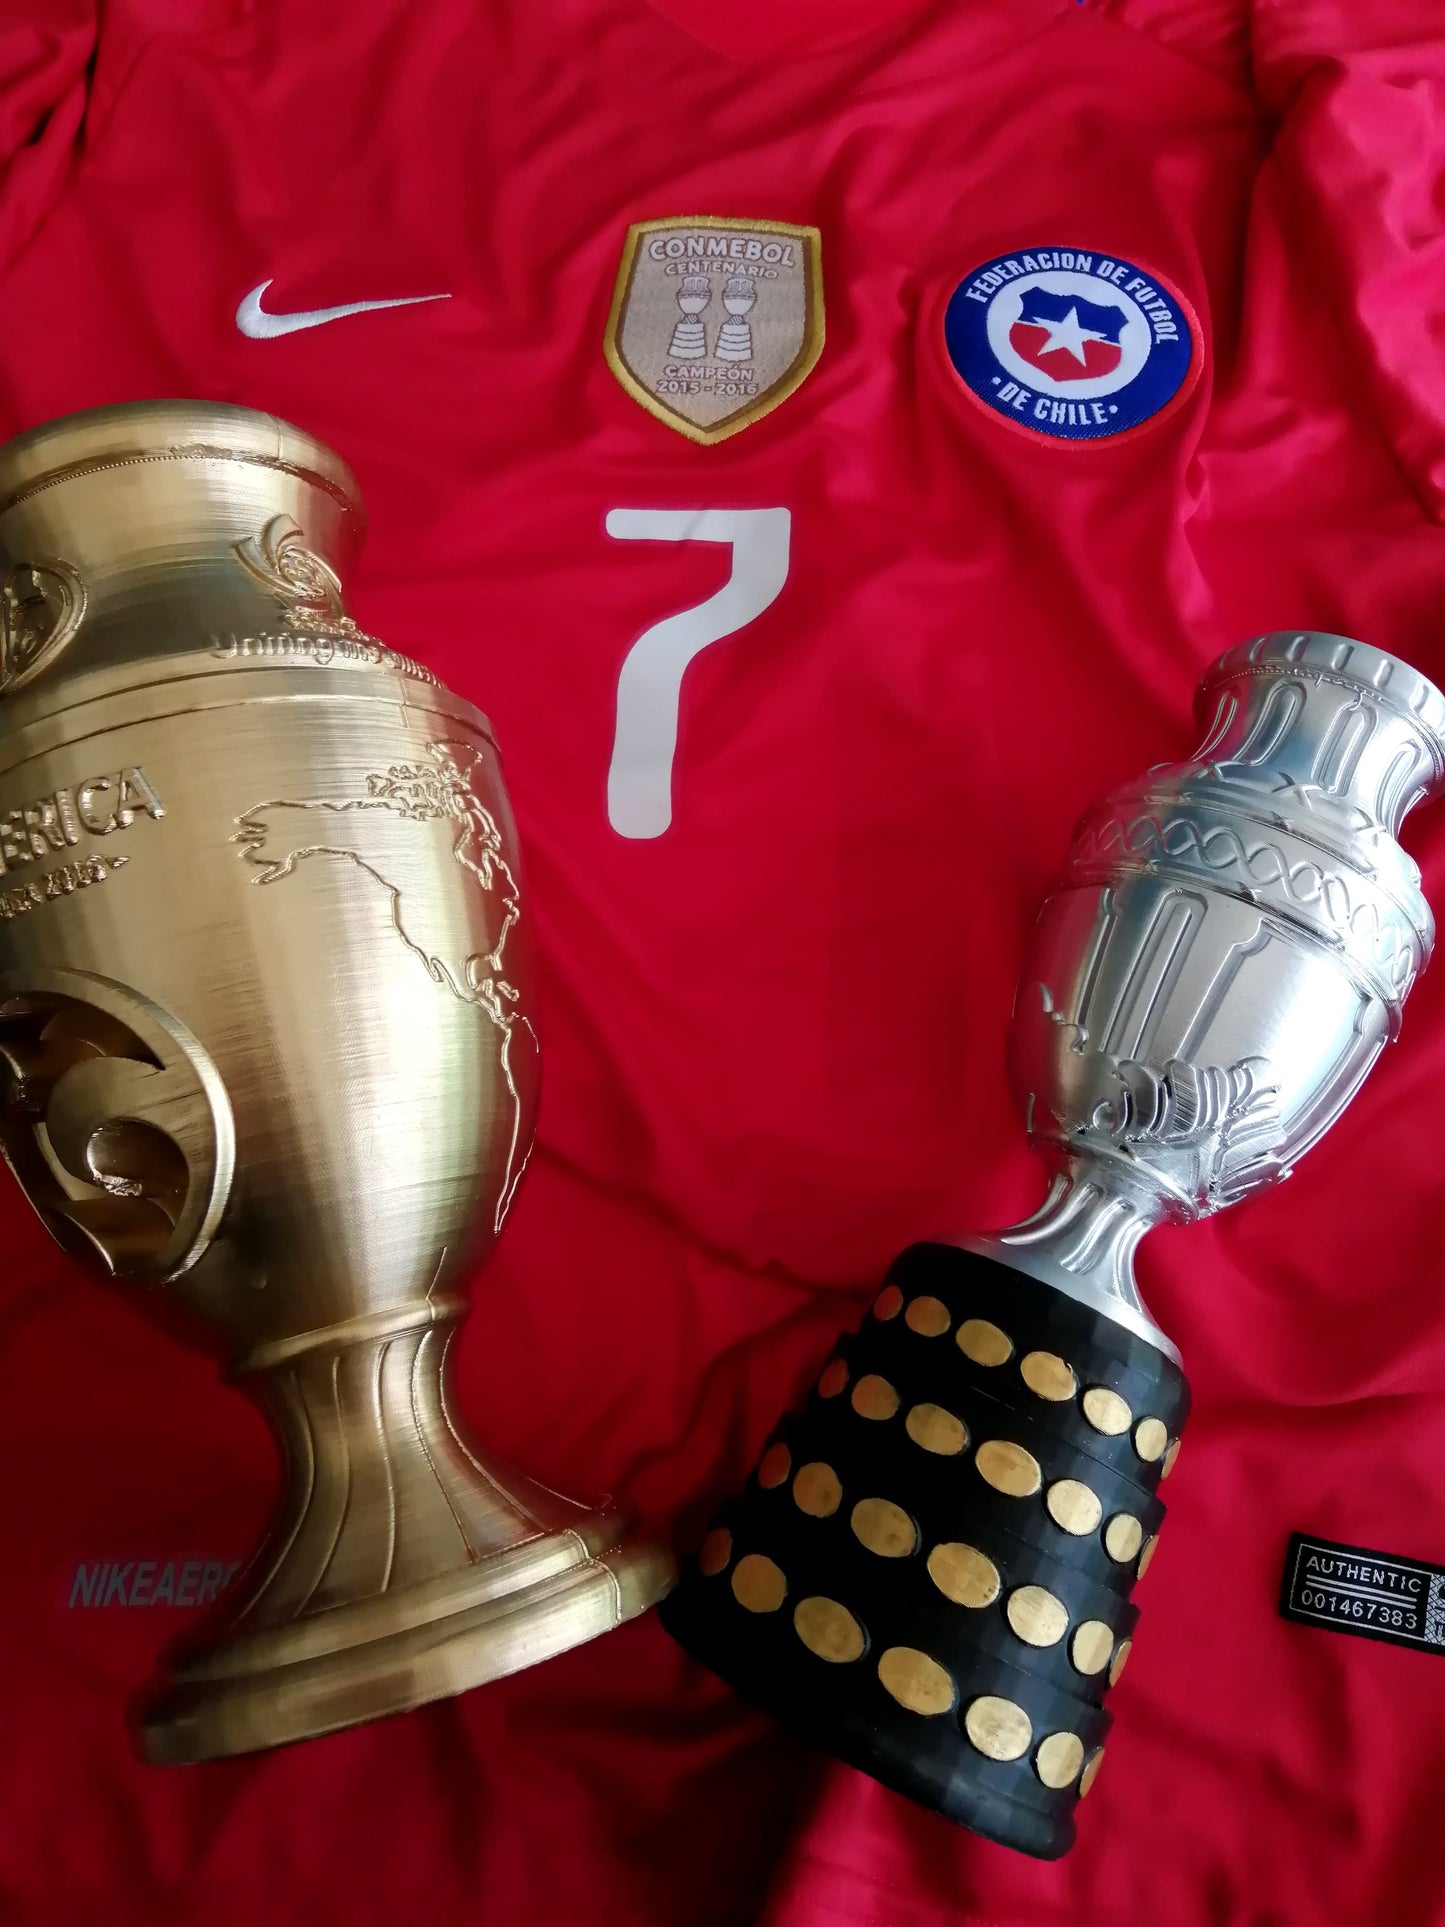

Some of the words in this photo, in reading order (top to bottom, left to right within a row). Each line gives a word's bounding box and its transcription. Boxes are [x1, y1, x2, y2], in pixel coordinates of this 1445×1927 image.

[649, 236, 796, 267] CONMEBOL
[665, 261, 779, 280] CENTENARIO
[965, 252, 1093, 304] FEDERACION
[1096, 259, 1129, 286] DE
[1125, 276, 1179, 345] FUTBOL
[657, 380, 700, 395] 2015
[714, 382, 759, 396] 2016
[996, 381, 1032, 411] DE
[1034, 398, 1109, 425] CHILE
[605, 507, 791, 839] 7
[0, 766, 167, 877] ERICA
[1305, 1555, 1422, 1593] AUTHENTIC
[1301, 1589, 1418, 1630] 001467383
